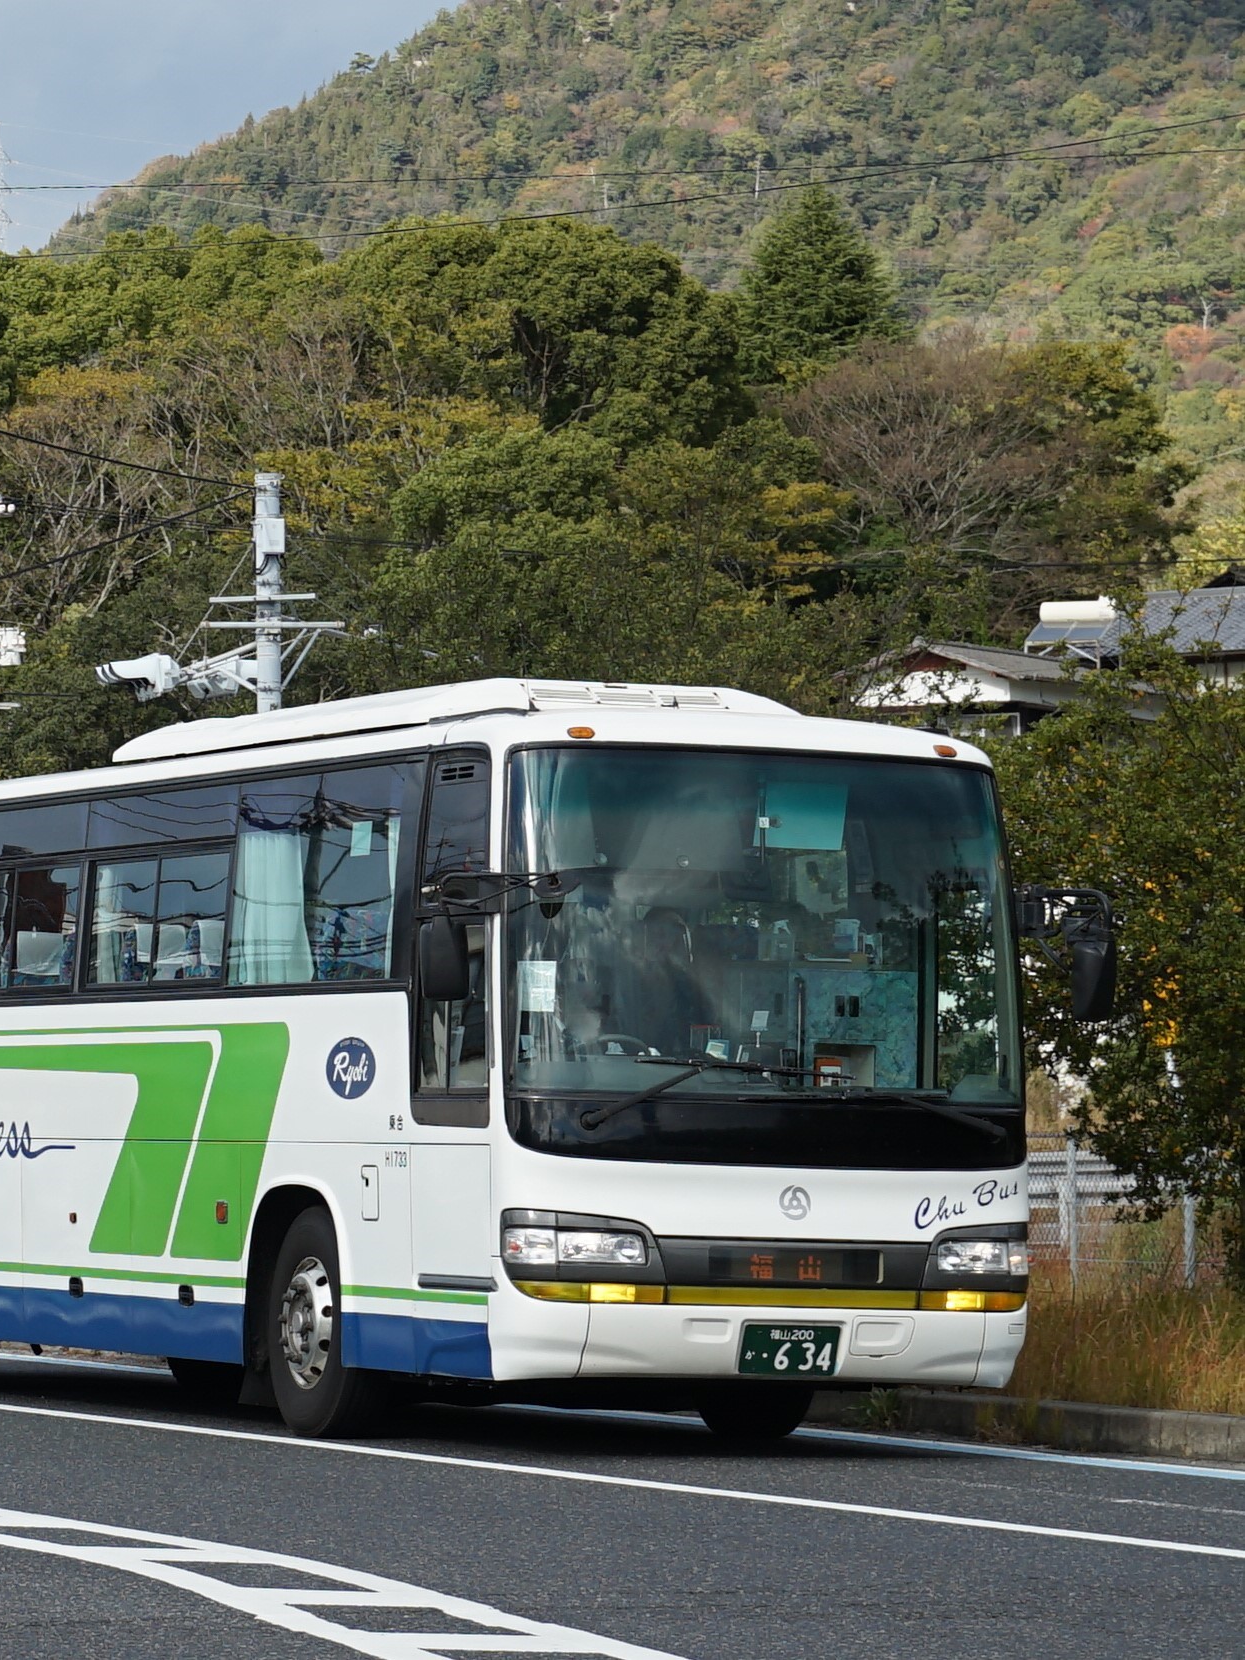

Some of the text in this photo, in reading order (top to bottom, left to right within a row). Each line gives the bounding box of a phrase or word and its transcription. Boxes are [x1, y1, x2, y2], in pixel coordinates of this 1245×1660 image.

[333, 1051, 369, 1096] Ryobi
[914, 1179, 1019, 1230] Chu Bus
